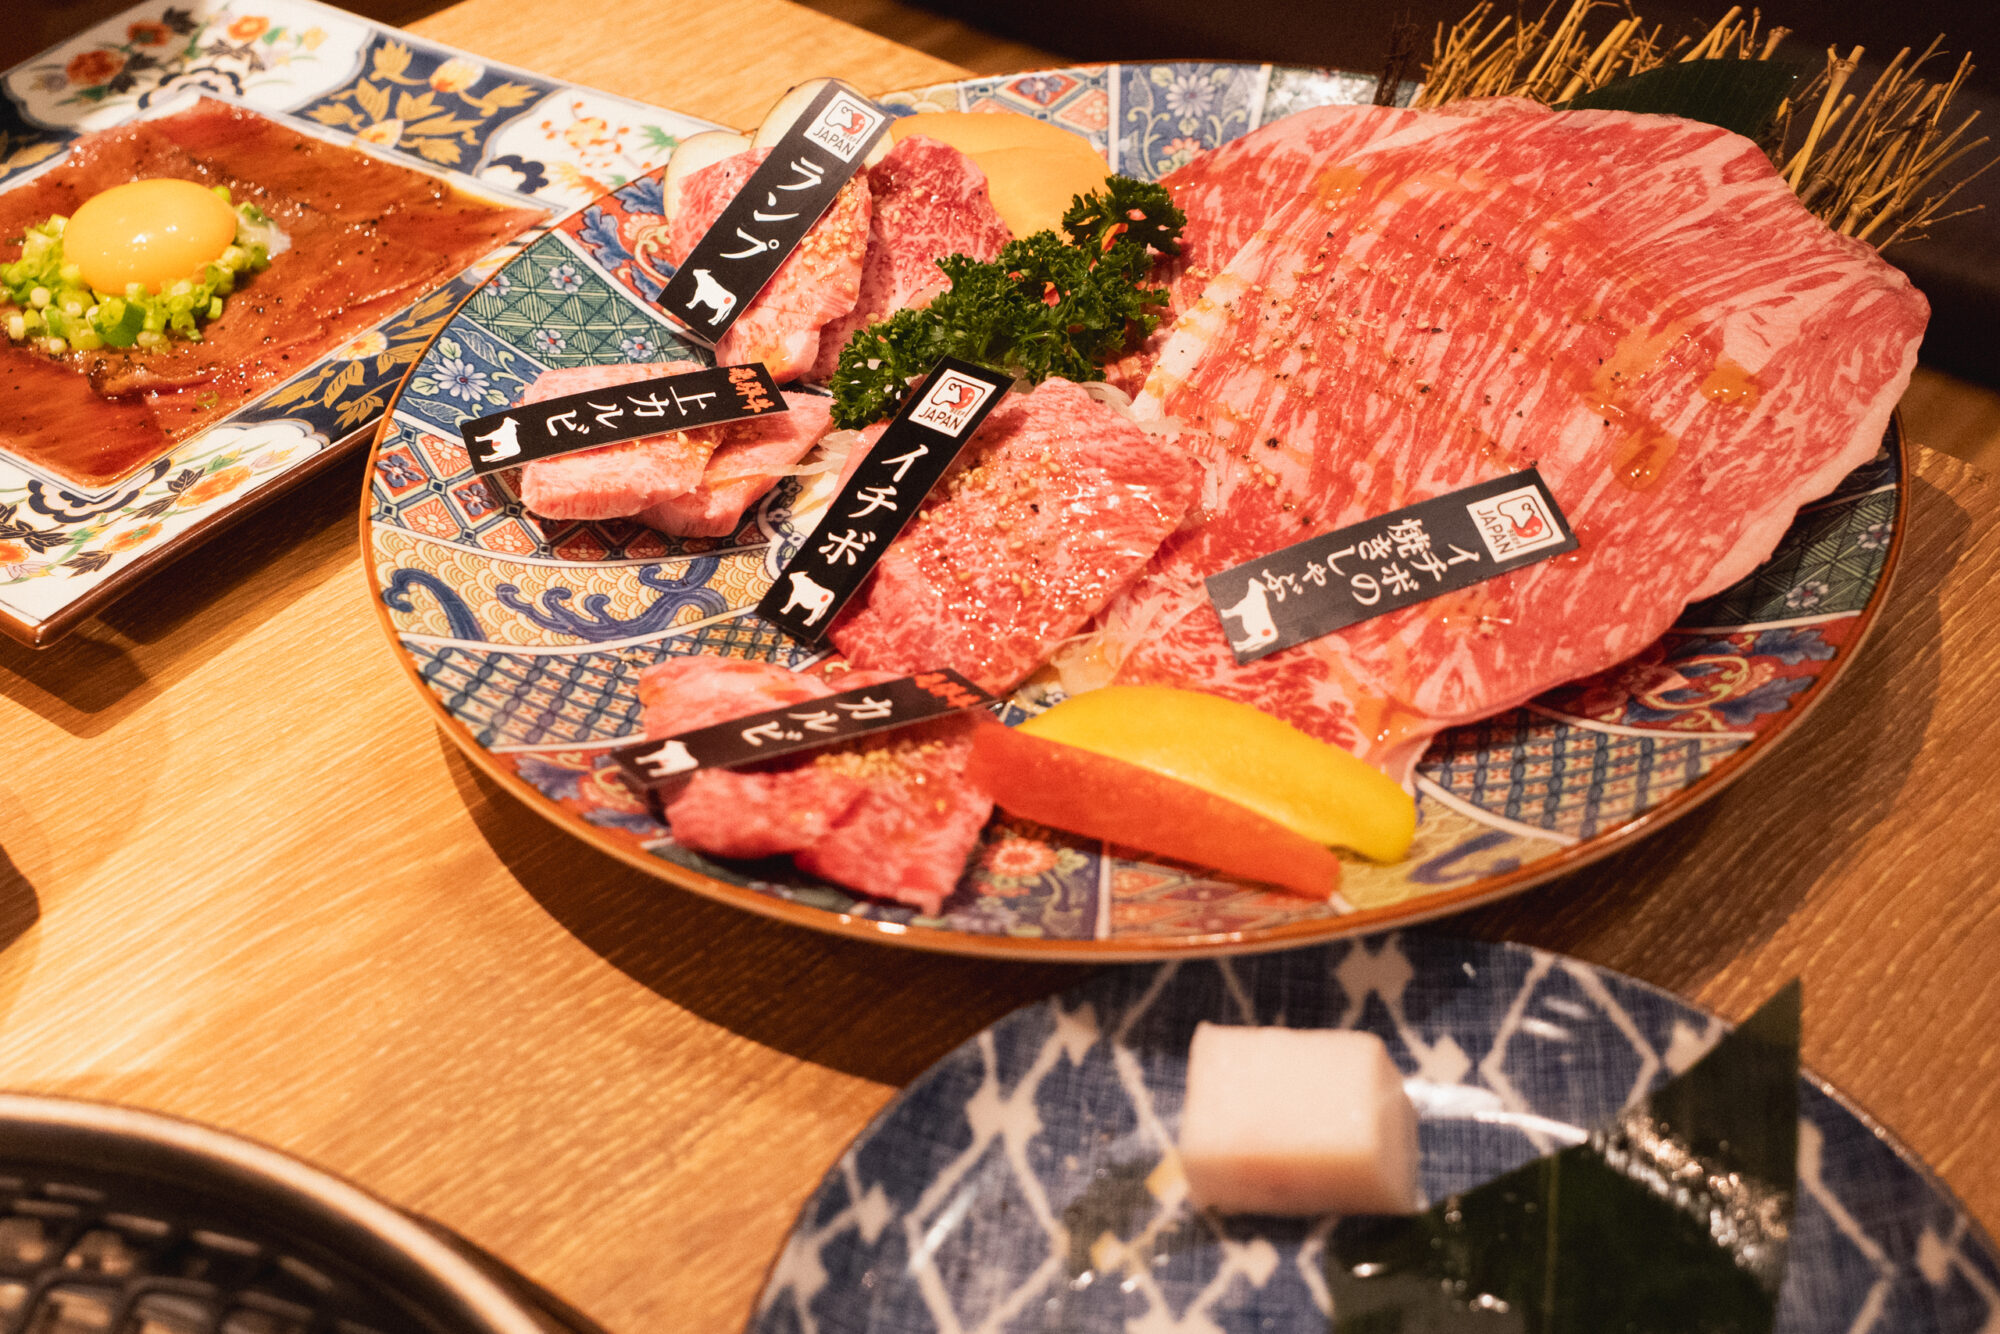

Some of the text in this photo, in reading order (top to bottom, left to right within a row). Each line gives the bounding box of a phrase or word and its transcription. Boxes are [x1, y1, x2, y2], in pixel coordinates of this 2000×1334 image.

[813, 127, 855, 156] JAPAN
[720, 156, 825, 259] ランプ
[546, 386, 717, 437] 上カルビ
[918, 407, 964, 430] JAPAN
[818, 444, 929, 566] イチボ
[1477, 509, 1515, 554] JAPAN
[1261, 518, 1432, 602] 焼きしゃぶ
[1350, 544, 1480, 606] イチボの
[741, 695, 893, 746] カルビ
